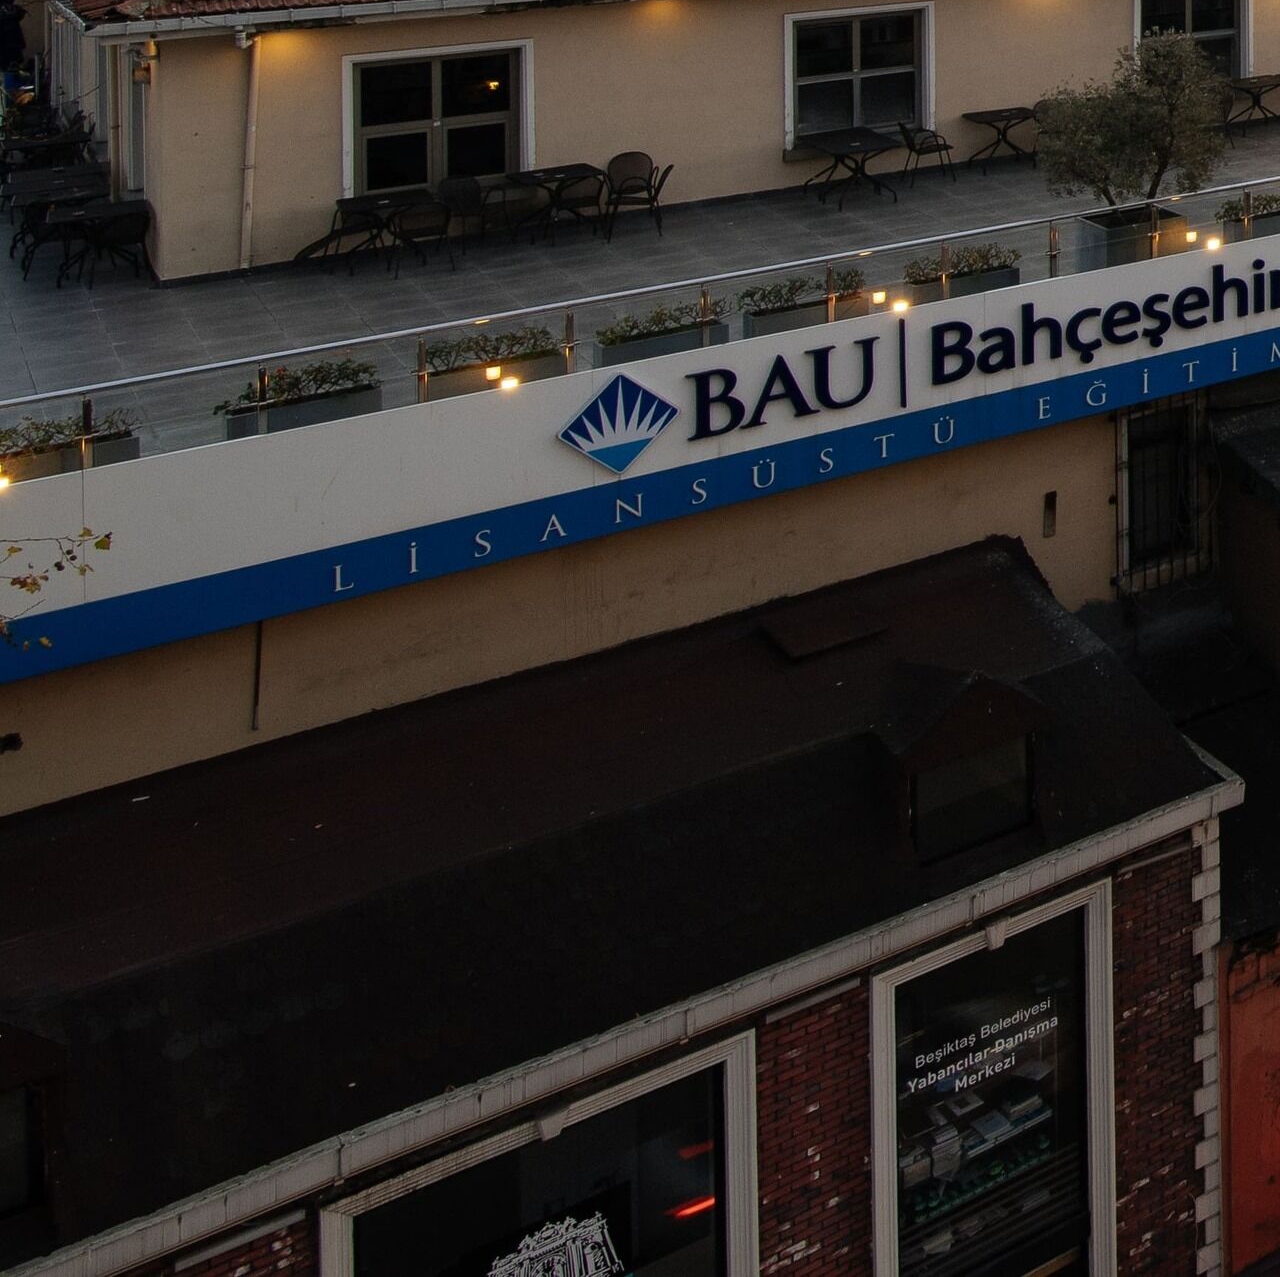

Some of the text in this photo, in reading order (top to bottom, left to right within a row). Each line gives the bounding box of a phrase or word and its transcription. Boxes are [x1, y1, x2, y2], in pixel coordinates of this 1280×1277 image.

[685, 336, 881, 443] BAU
[332, 415, 955, 593] LİSANSÜSTÜ
[915, 996, 1051, 1068] Beşiktaş Belediyesi
[907, 1046, 991, 1094] Yabancılar
[954, 1052, 1016, 1092] Merkezi
